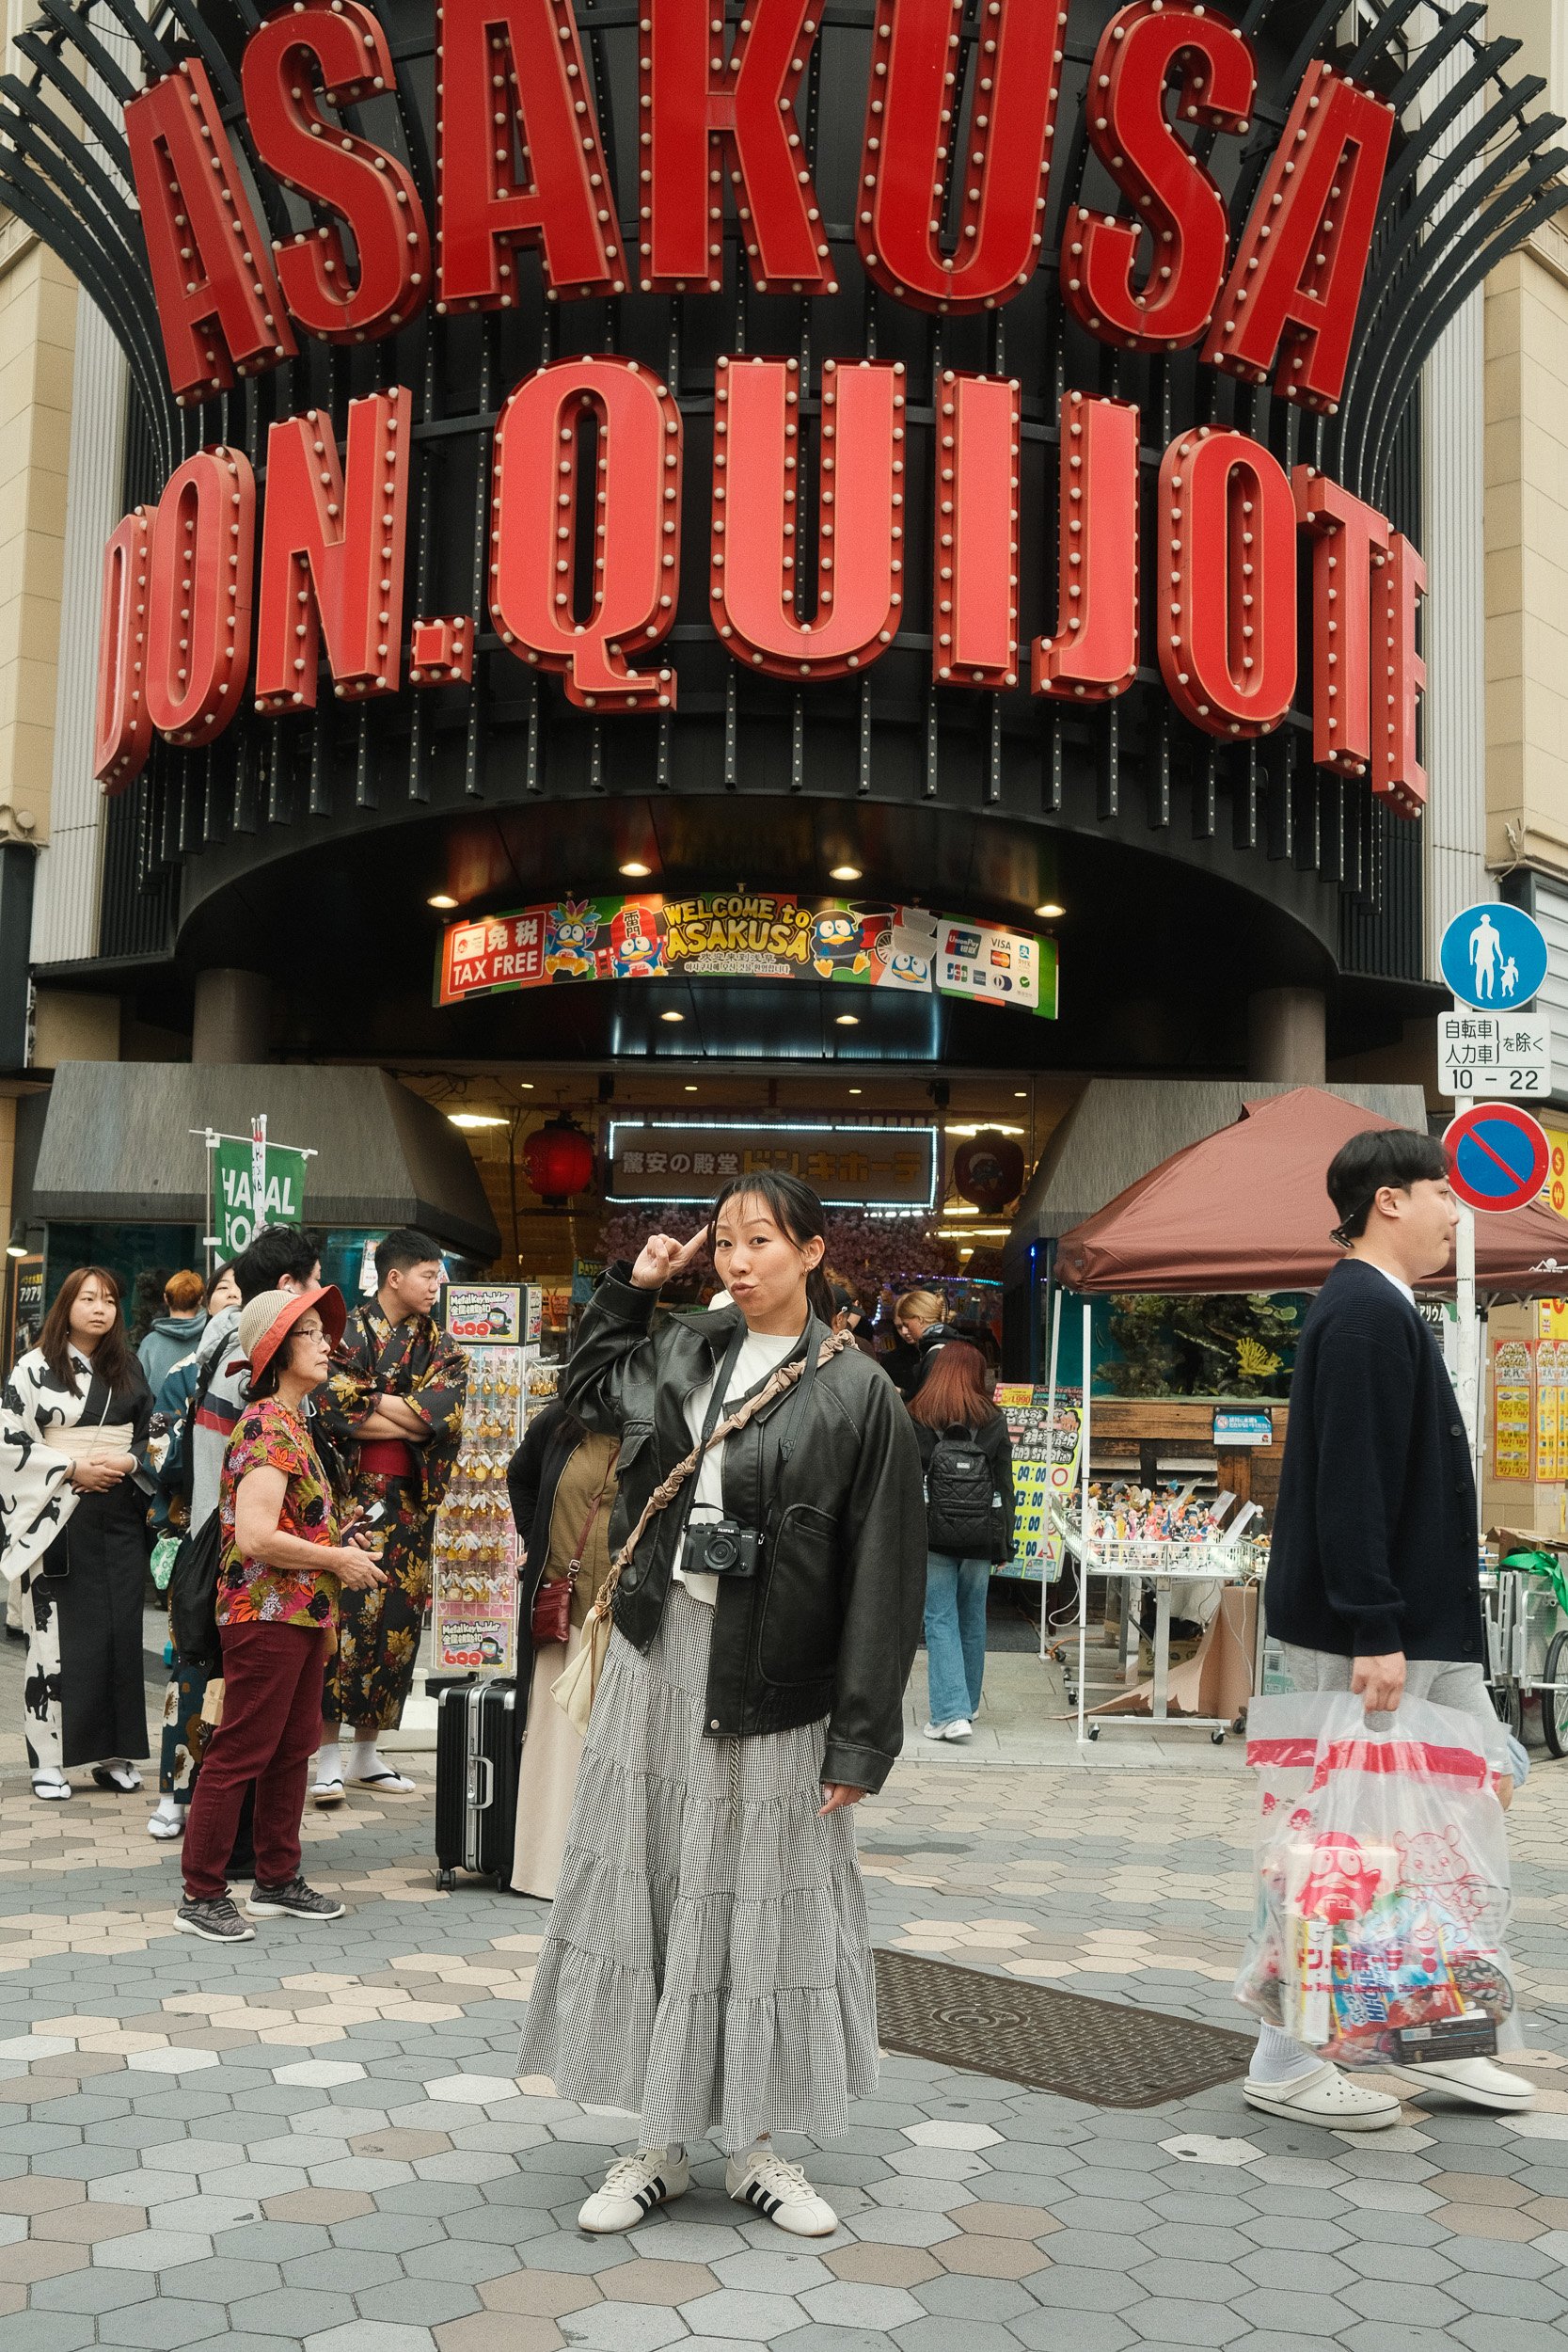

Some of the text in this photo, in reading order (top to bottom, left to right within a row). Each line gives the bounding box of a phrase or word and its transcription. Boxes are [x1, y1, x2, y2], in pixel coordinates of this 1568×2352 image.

[123, 0, 1397, 414] ASAKUSA
[624, 910, 641, 937] 雷門
[664, 897, 811, 929] WELCOME to
[487, 919, 538, 953] 免税
[666, 917, 811, 961] ASAKUSA
[991, 937, 1011, 950] VISA
[453, 950, 538, 986] TAX FREE
[1446, 1020, 1493, 1040] 自転車
[1503, 1032, 1544, 1053] を除く
[1445, 1043, 1493, 1065] 人力車
[1453, 1070, 1473, 1089] 10
[1510, 1070, 1538, 1090] 22
[222, 1167, 295, 1216] HAAL
[452, 1320, 490, 1336] 600
[1031, 1447, 1072, 1462] sitation
[1015, 1515, 1040, 1532] 0:00
[444, 1649, 483, 1666] 600
